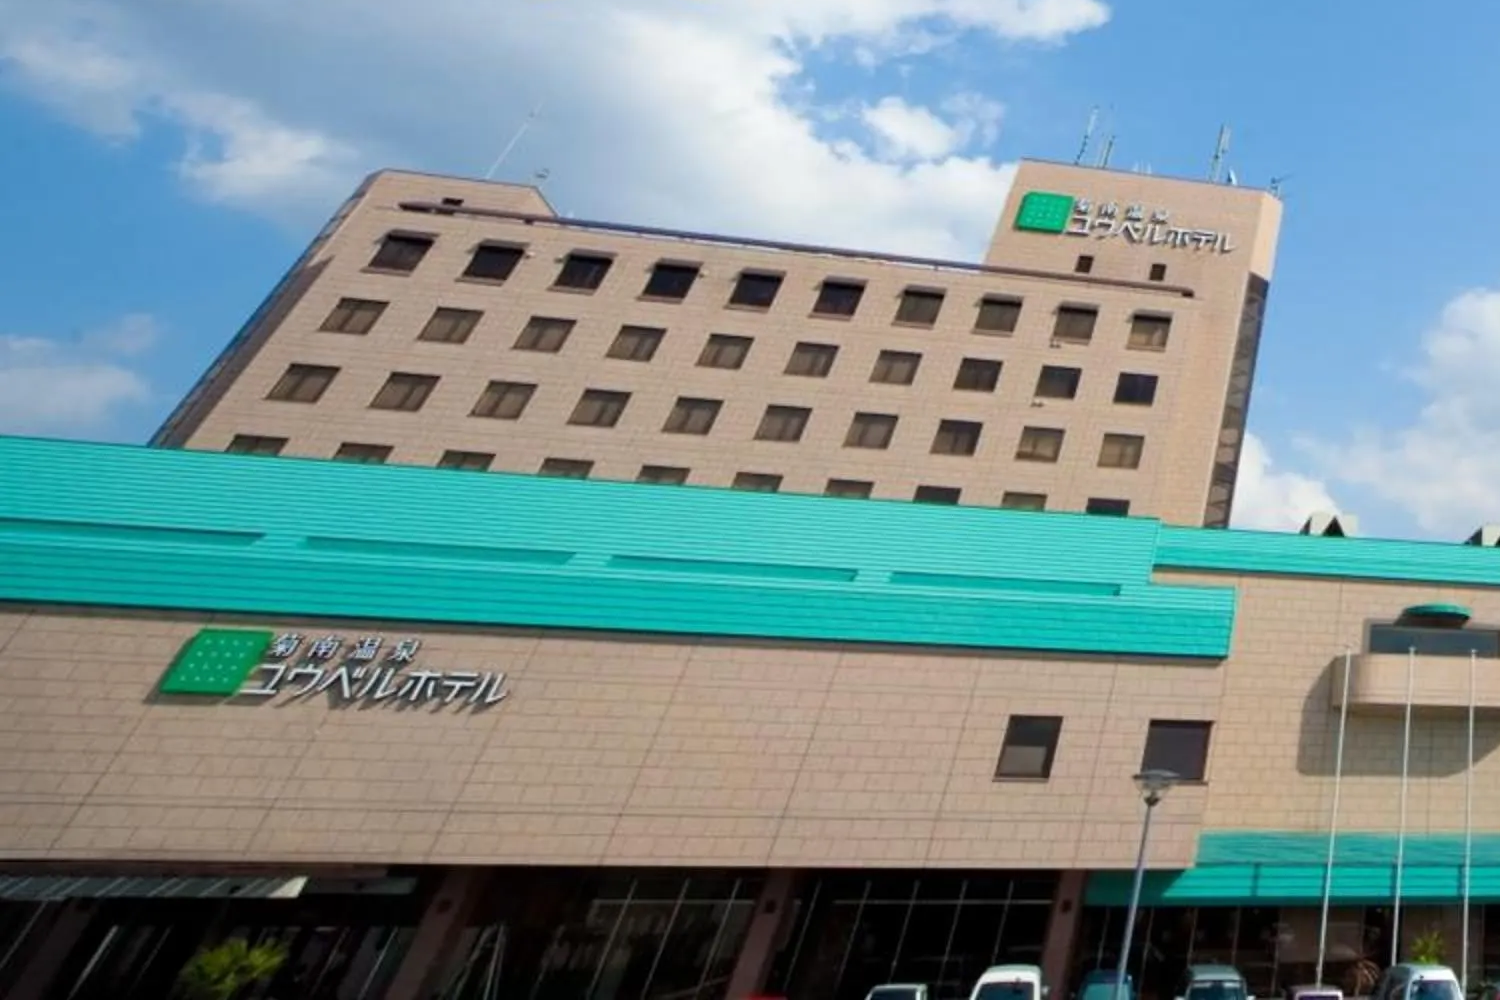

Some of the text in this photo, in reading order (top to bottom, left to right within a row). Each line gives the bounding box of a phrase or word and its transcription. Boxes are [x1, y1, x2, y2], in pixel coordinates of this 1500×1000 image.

[271, 632, 420, 662] 菊南温泉
[239, 663, 505, 702] ユウベルホテル
